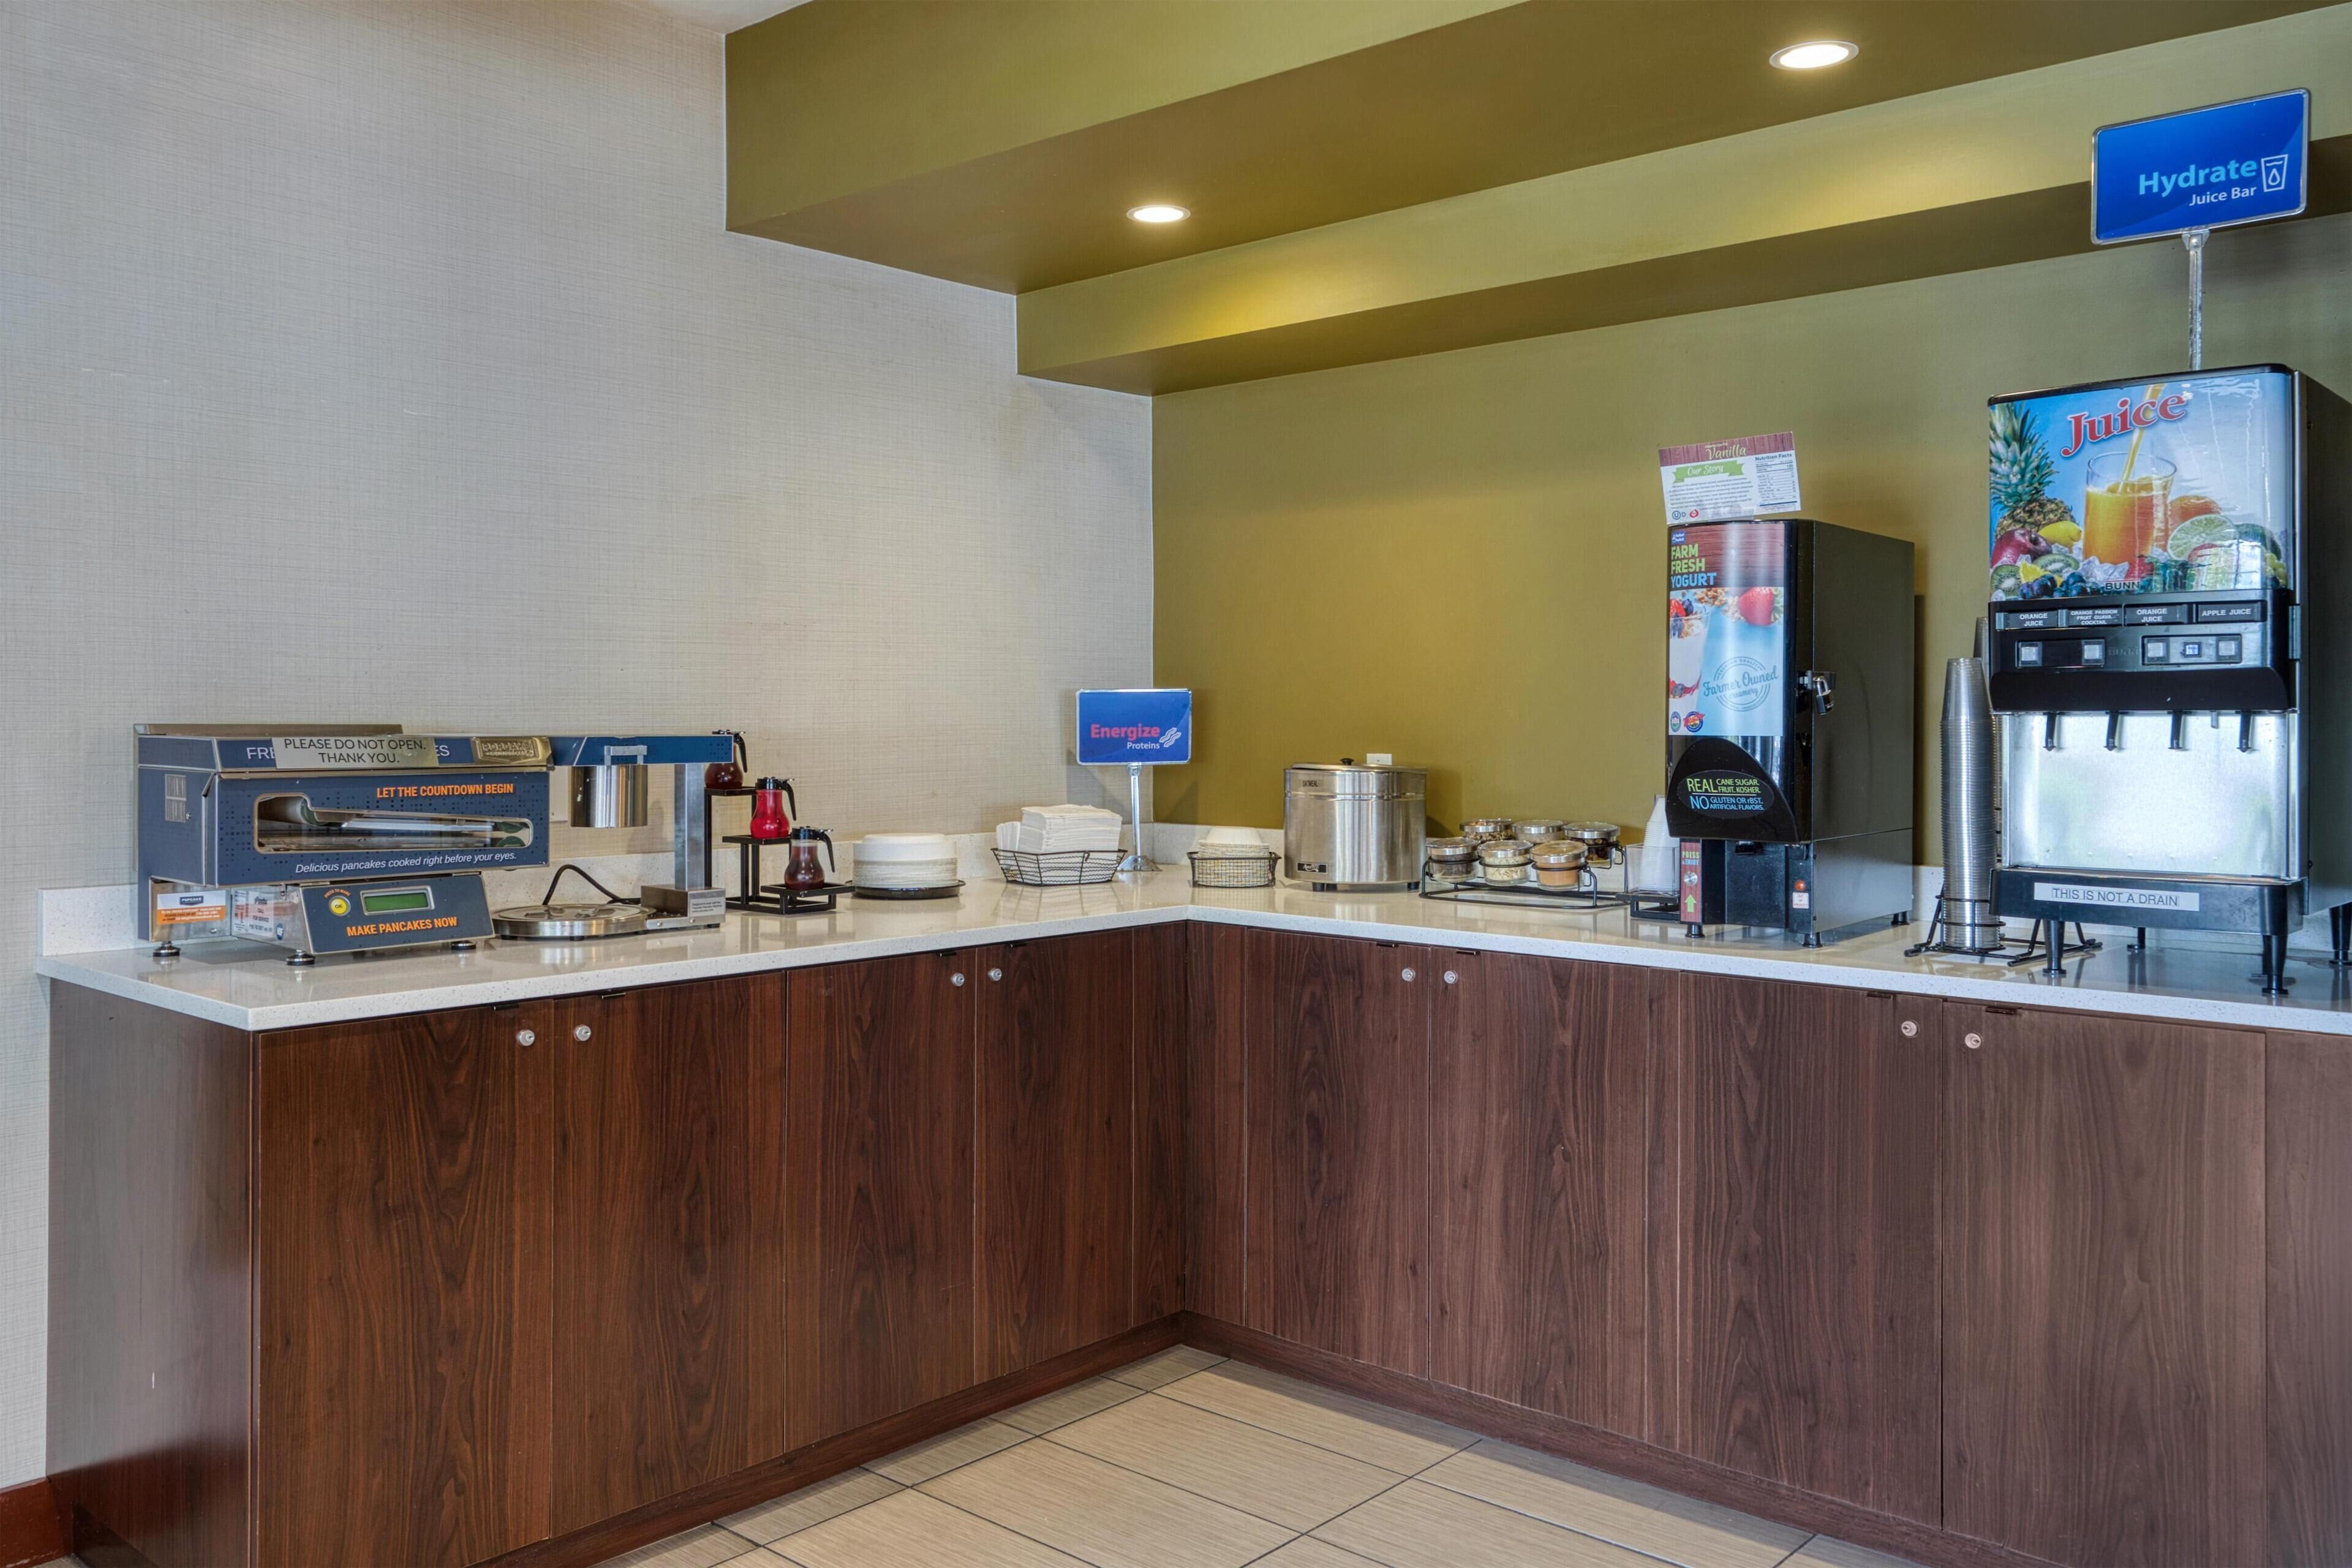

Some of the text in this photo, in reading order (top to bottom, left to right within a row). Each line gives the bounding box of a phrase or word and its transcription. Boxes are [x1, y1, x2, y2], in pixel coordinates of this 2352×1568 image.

[2139, 159, 2258, 197] Hydrate
[2188, 186, 2257, 206] Juice Bar
[2060, 394, 2187, 457] Juice
[1705, 444, 1747, 460] Vanilla
[1687, 465, 1724, 475] Our Story
[1671, 543, 1698, 560] FARM
[1671, 558, 1705, 575] FRESH
[1671, 572, 1717, 588] YOGURT
[2105, 581, 2140, 590] BUNN
[1703, 665, 1779, 697] Farmer Owned
[1090, 723, 1160, 741] Energize
[284, 739, 426, 750] PLEASE DO NOT OPEN.
[318, 753, 399, 763] THANK YOU.
[377, 784, 513, 797] LET THE COUNTDOWN BEGIN
[1686, 778, 1718, 793] REAL
[1689, 796, 1709, 810] NO
[295, 852, 517, 873] Delicious pancakes cooked right before your eyes.
[2053, 888, 2178, 907] THIS IS NOT A DRAIN
[347, 917, 458, 937] MAKE PANCAKES NOW
